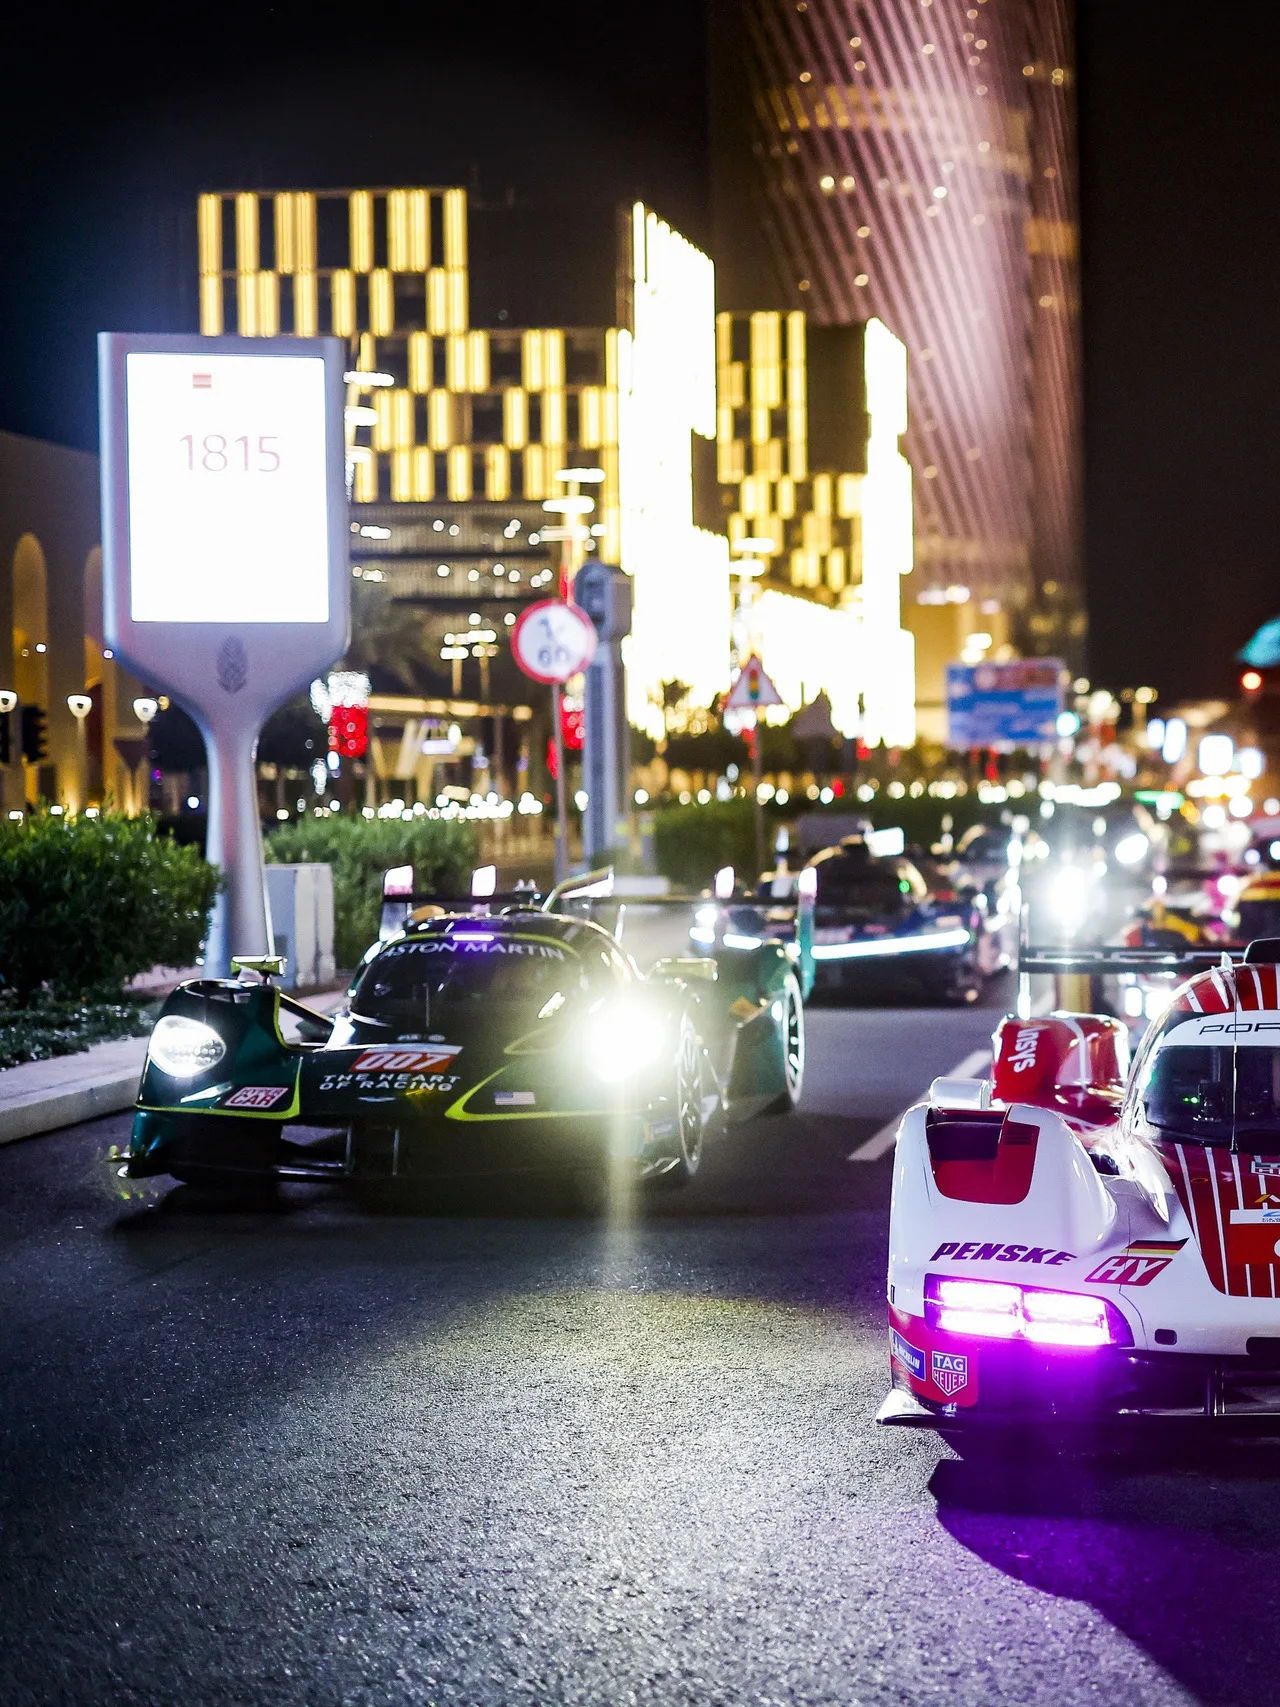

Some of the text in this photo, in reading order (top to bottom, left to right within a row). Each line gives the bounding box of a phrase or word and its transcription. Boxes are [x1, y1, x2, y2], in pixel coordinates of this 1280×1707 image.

[180, 434, 280, 472] 1815
[379, 942, 565, 961] ASTON MARTIN
[355, 1053, 451, 1070] 007
[319, 1081, 453, 1091] OF RACING
[324, 1073, 461, 1083] THE HEART
[230, 1093, 275, 1105] CAR
[929, 1242, 1077, 1266] PENSKE
[1090, 1259, 1160, 1282] HY
[934, 1354, 964, 1371] TAG
[933, 1370, 965, 1393] HEUER
